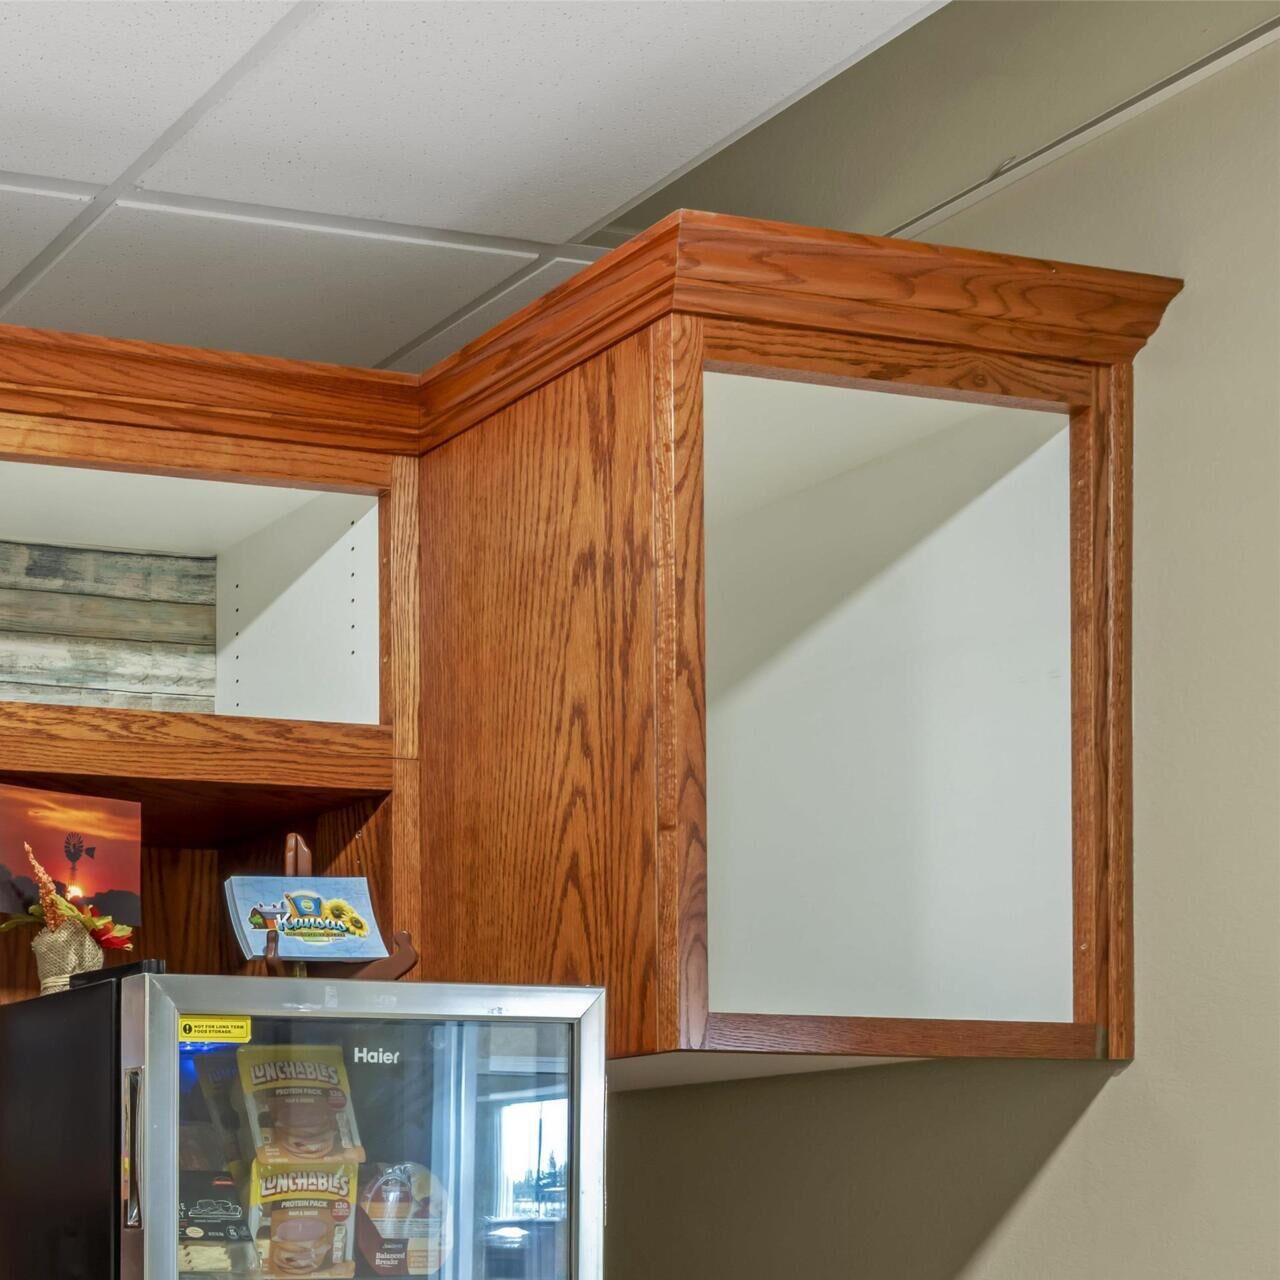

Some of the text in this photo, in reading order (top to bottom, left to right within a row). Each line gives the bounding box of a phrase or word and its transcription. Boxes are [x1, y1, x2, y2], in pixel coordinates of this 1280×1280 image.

[276, 913, 348, 931] Kansas
[354, 1048, 399, 1064] Haier
[251, 1061, 339, 1086] LUNCHABLES
[260, 1171, 349, 1196] LUNCHABLES
[281, 1200, 308, 1208] PROTEIN
[375, 1252, 405, 1260] Balanced
